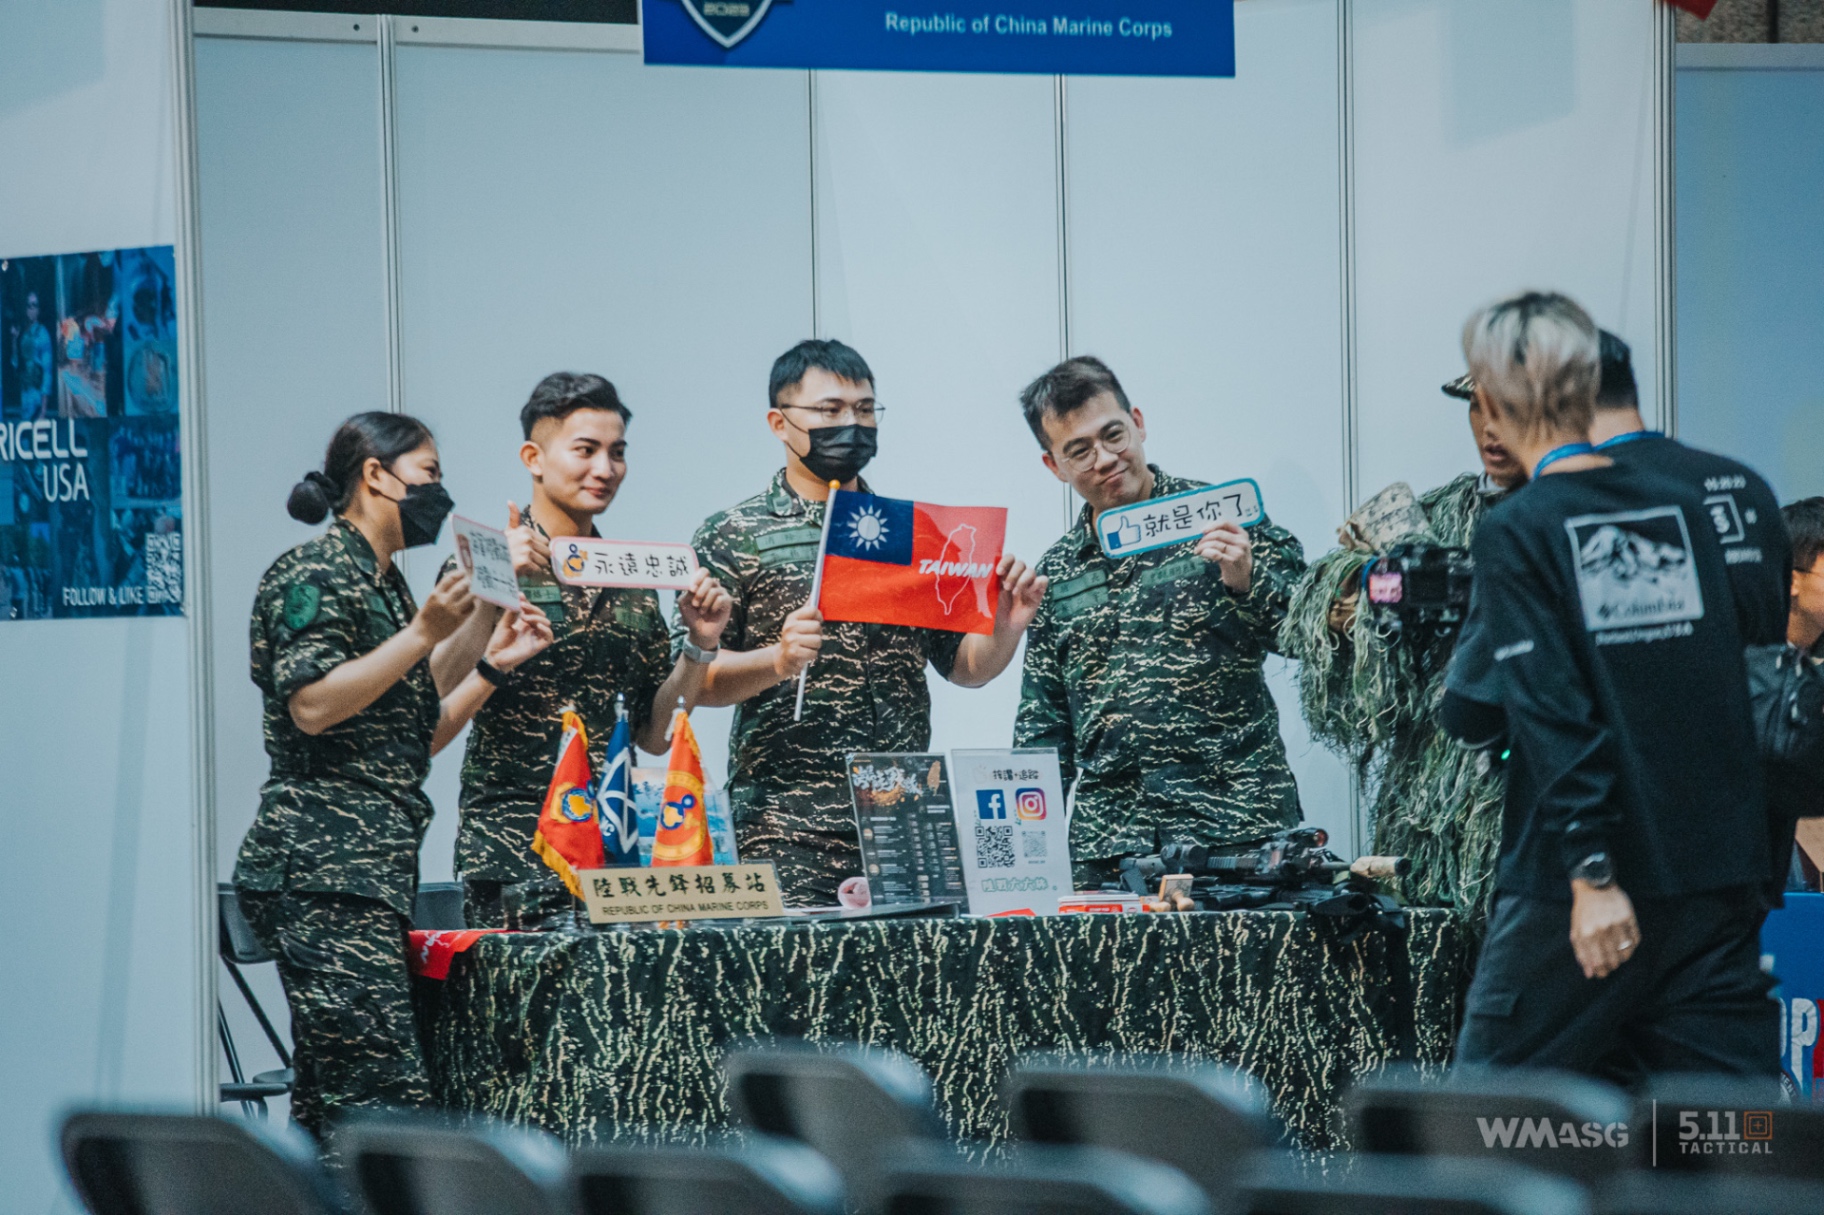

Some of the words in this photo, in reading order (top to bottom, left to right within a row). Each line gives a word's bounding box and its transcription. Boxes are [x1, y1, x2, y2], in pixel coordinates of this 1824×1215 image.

[885, 11, 966, 35] Republic
[971, 14, 991, 33] of
[995, 14, 1047, 35] China
[1053, 16, 1113, 37] Marine
[1119, 17, 1173, 41] Corps
[0, 418, 88, 461] RICELL
[43, 463, 90, 502] USA
[1143, 493, 1242, 537] 就是你了
[593, 552, 690, 578] 永遠忠誠
[919, 558, 993, 579] TAIWAN
[62, 586, 106, 606] FOLLOW
[108, 586, 117, 605] &
[118, 586, 144, 605] LIKE
[592, 872, 766, 898] 陸戰先鋒招募站
[602, 904, 649, 916] REPUBLIC
[652, 903, 664, 914] OF
[667, 903, 695, 914] CHINA
[698, 901, 734, 912] MARINE
[736, 900, 769, 911] CORPS
